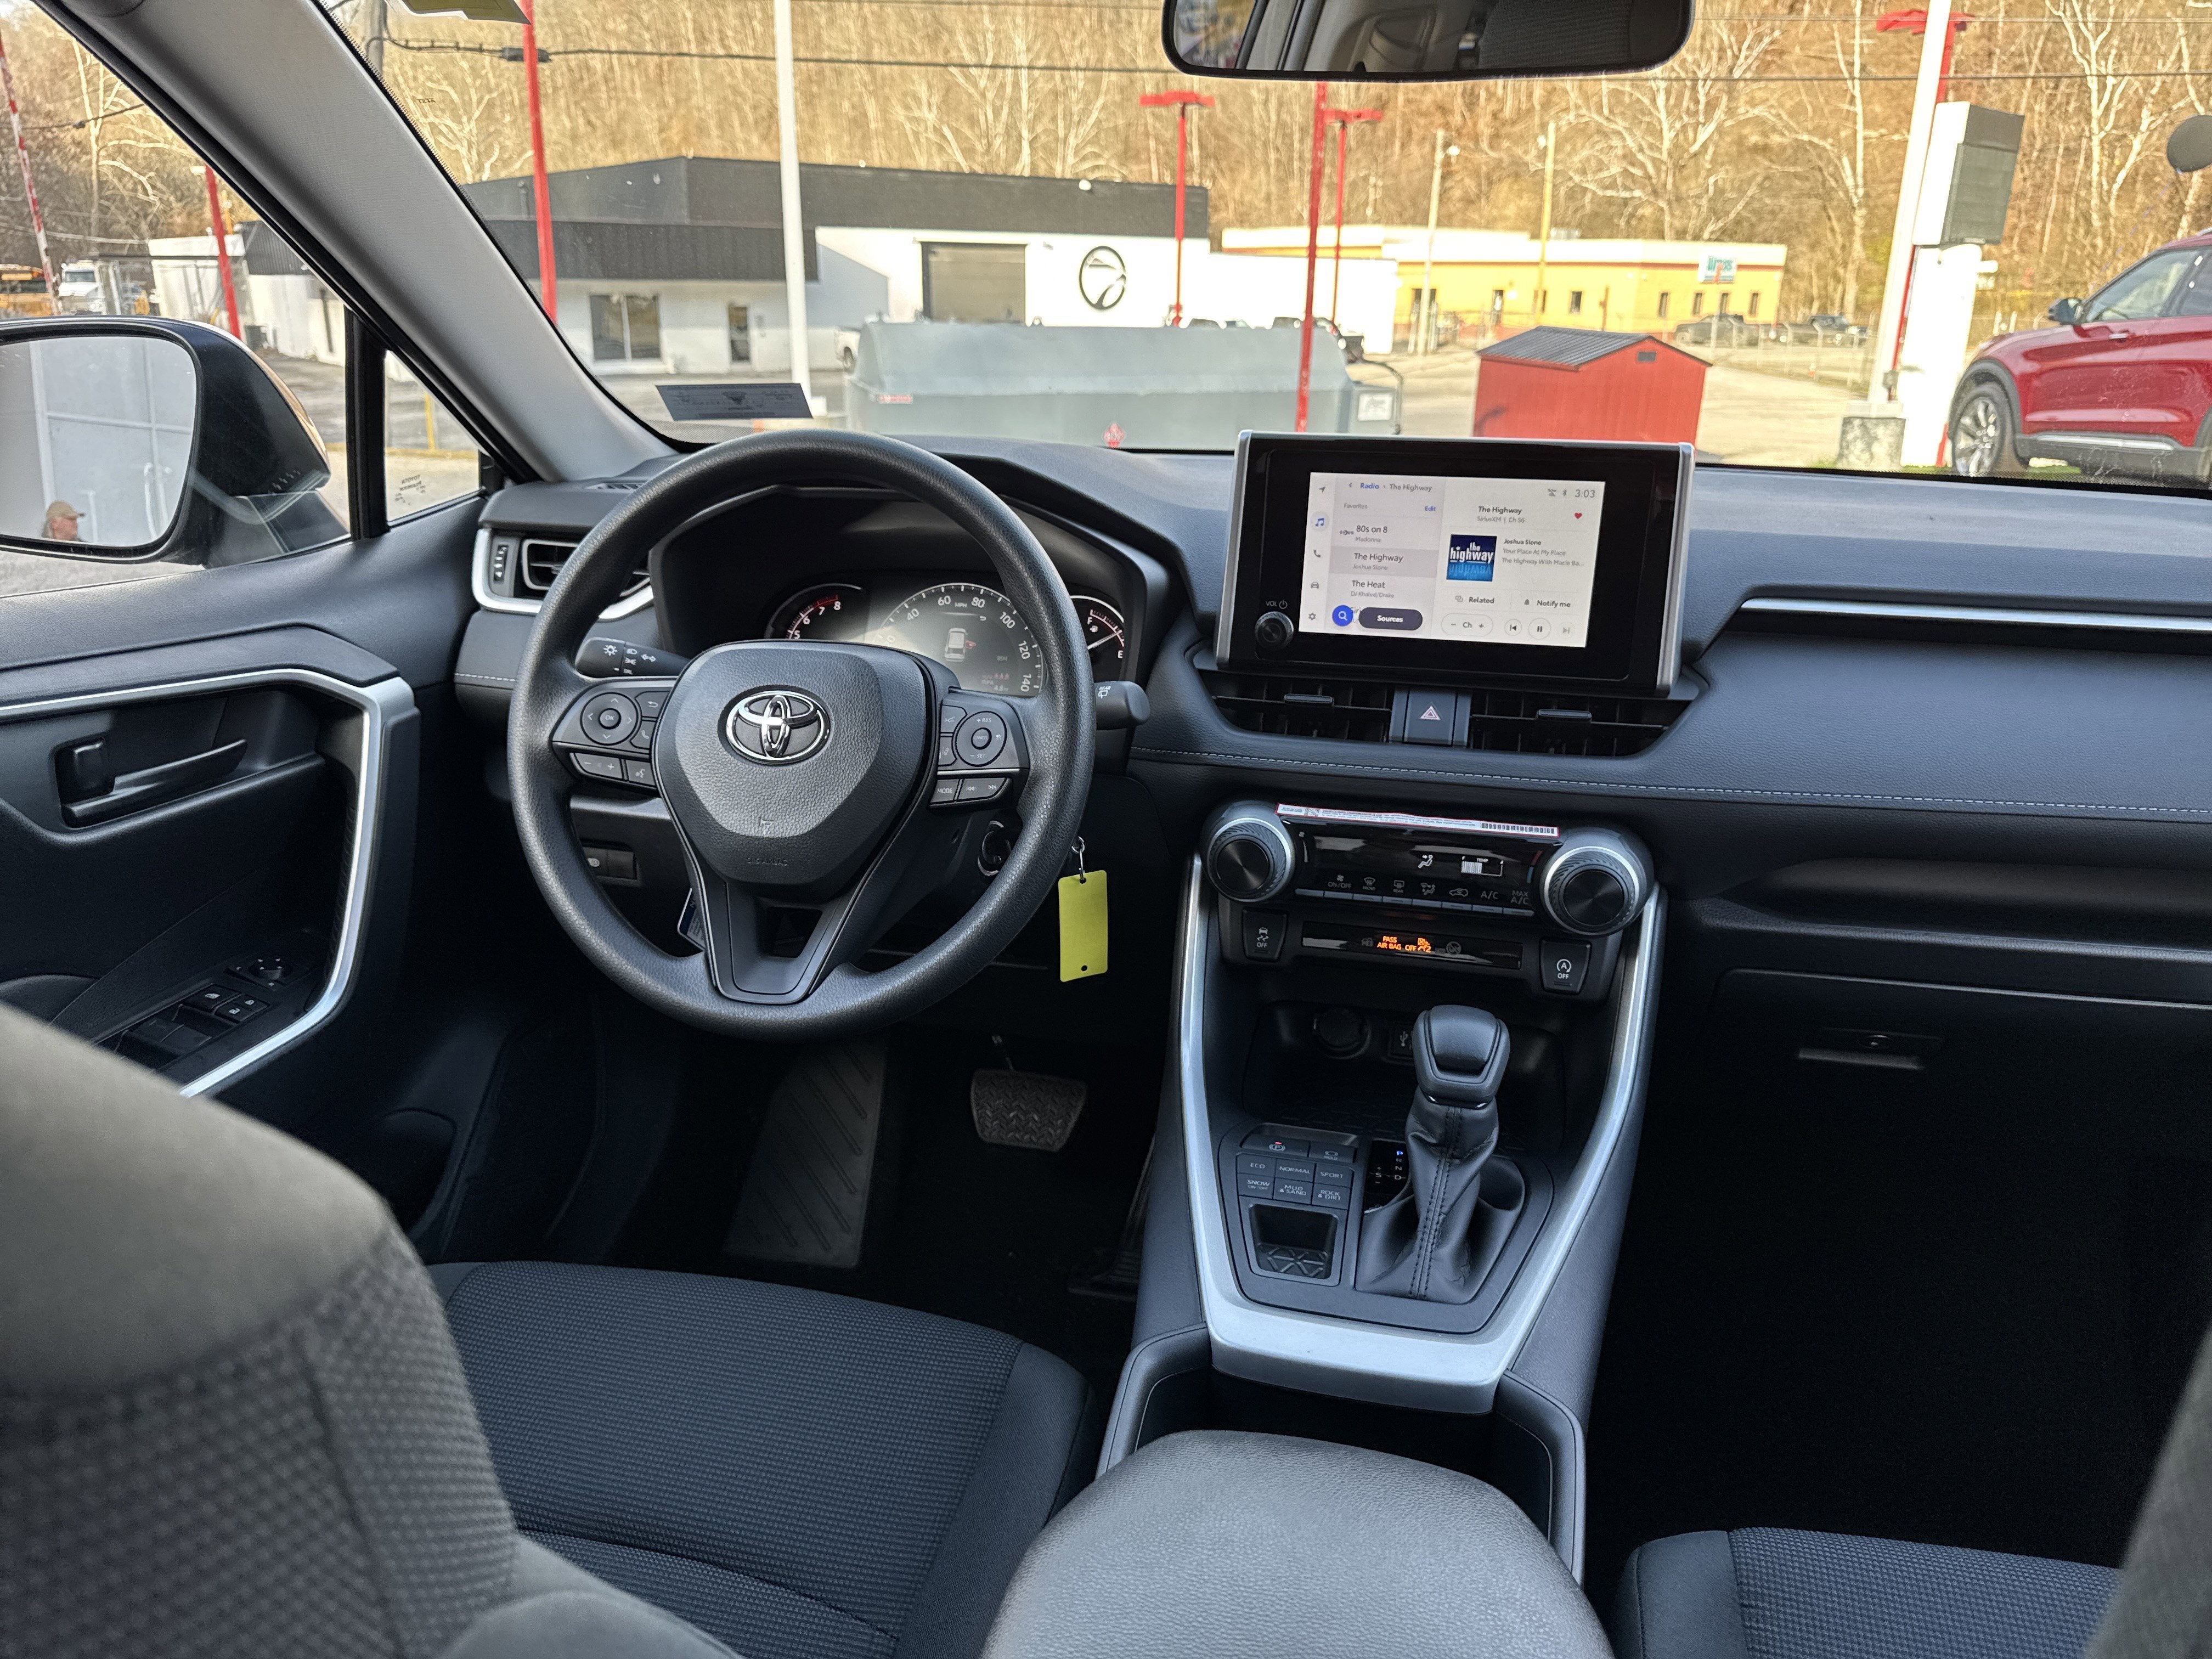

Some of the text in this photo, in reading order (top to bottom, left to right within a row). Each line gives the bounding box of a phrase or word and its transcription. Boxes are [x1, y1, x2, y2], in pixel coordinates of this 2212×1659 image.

[1403, 484, 1432, 493] Highway
[1575, 489, 1595, 498] 3:03
[1492, 507, 1522, 515] Highway
[1469, 542, 1481, 551] the
[1369, 554, 1403, 563] Highway
[1450, 546, 1494, 564] highway
[938, 595, 951, 606] 60
[970, 596, 985, 608] 80
[1537, 600, 1558, 608] Notify
[833, 601, 841, 611] 8
[818, 606, 826, 616] 7
[906, 608, 919, 621] 40
[803, 616, 810, 625] 6
[1000, 611, 1015, 629] 100
[1087, 617, 1093, 625] F
[794, 630, 800, 640] 5
[1018, 641, 1031, 659] 120
[1117, 651, 1124, 659] E
[1020, 674, 1032, 692] 140
[1481, 891, 1499, 900] A/C
[1510, 896, 1529, 905] A/C
[1383, 935, 1397, 944] PASS
[1279, 1166, 1310, 1174] NORMAL
